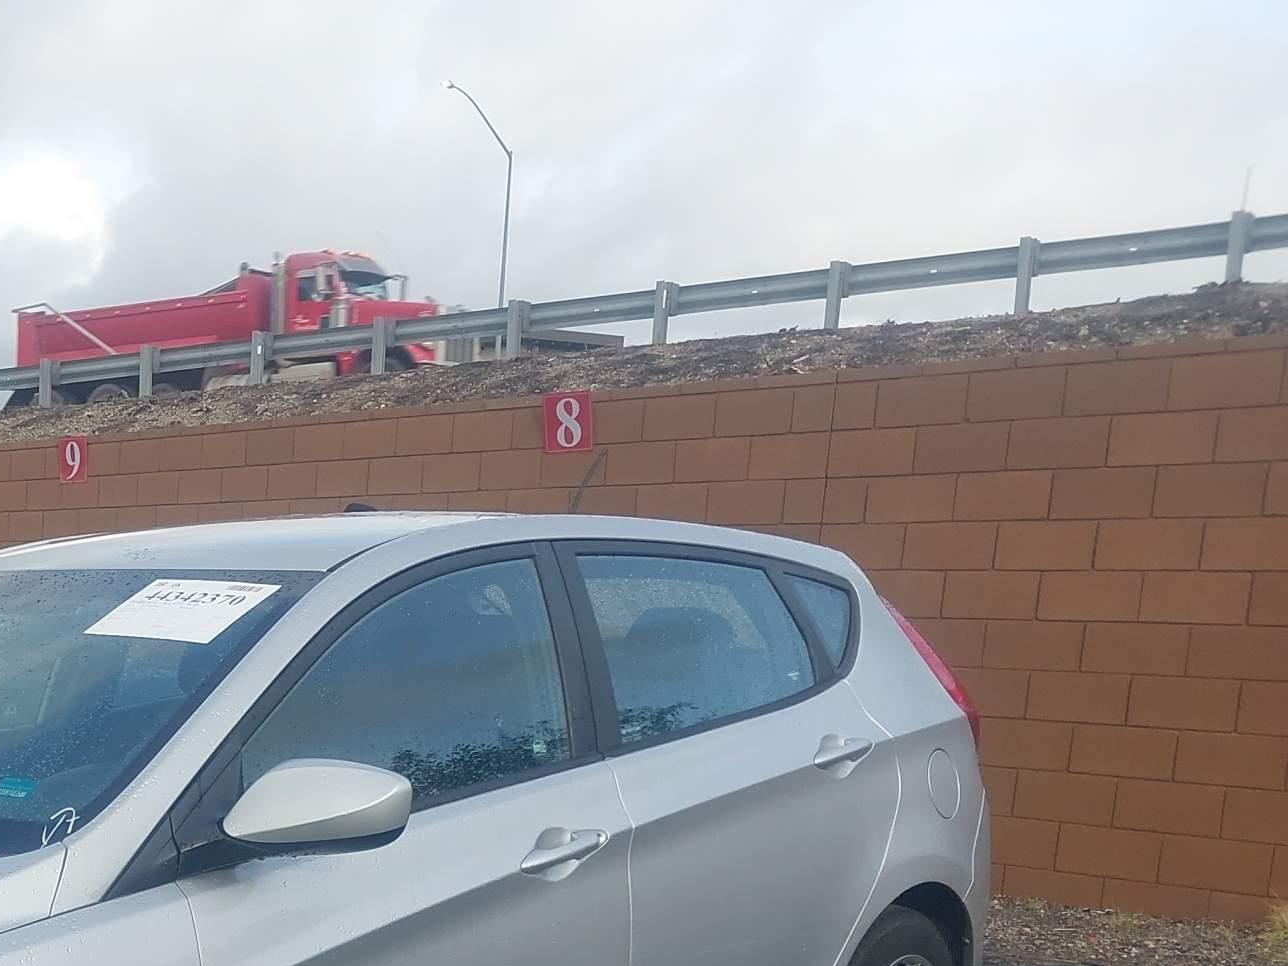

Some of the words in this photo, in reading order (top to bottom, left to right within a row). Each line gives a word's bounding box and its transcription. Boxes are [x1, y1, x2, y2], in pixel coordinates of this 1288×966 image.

[556, 397, 582, 448] 8
[65, 441, 81, 480] 9
[144, 590, 248, 606] 44342370
